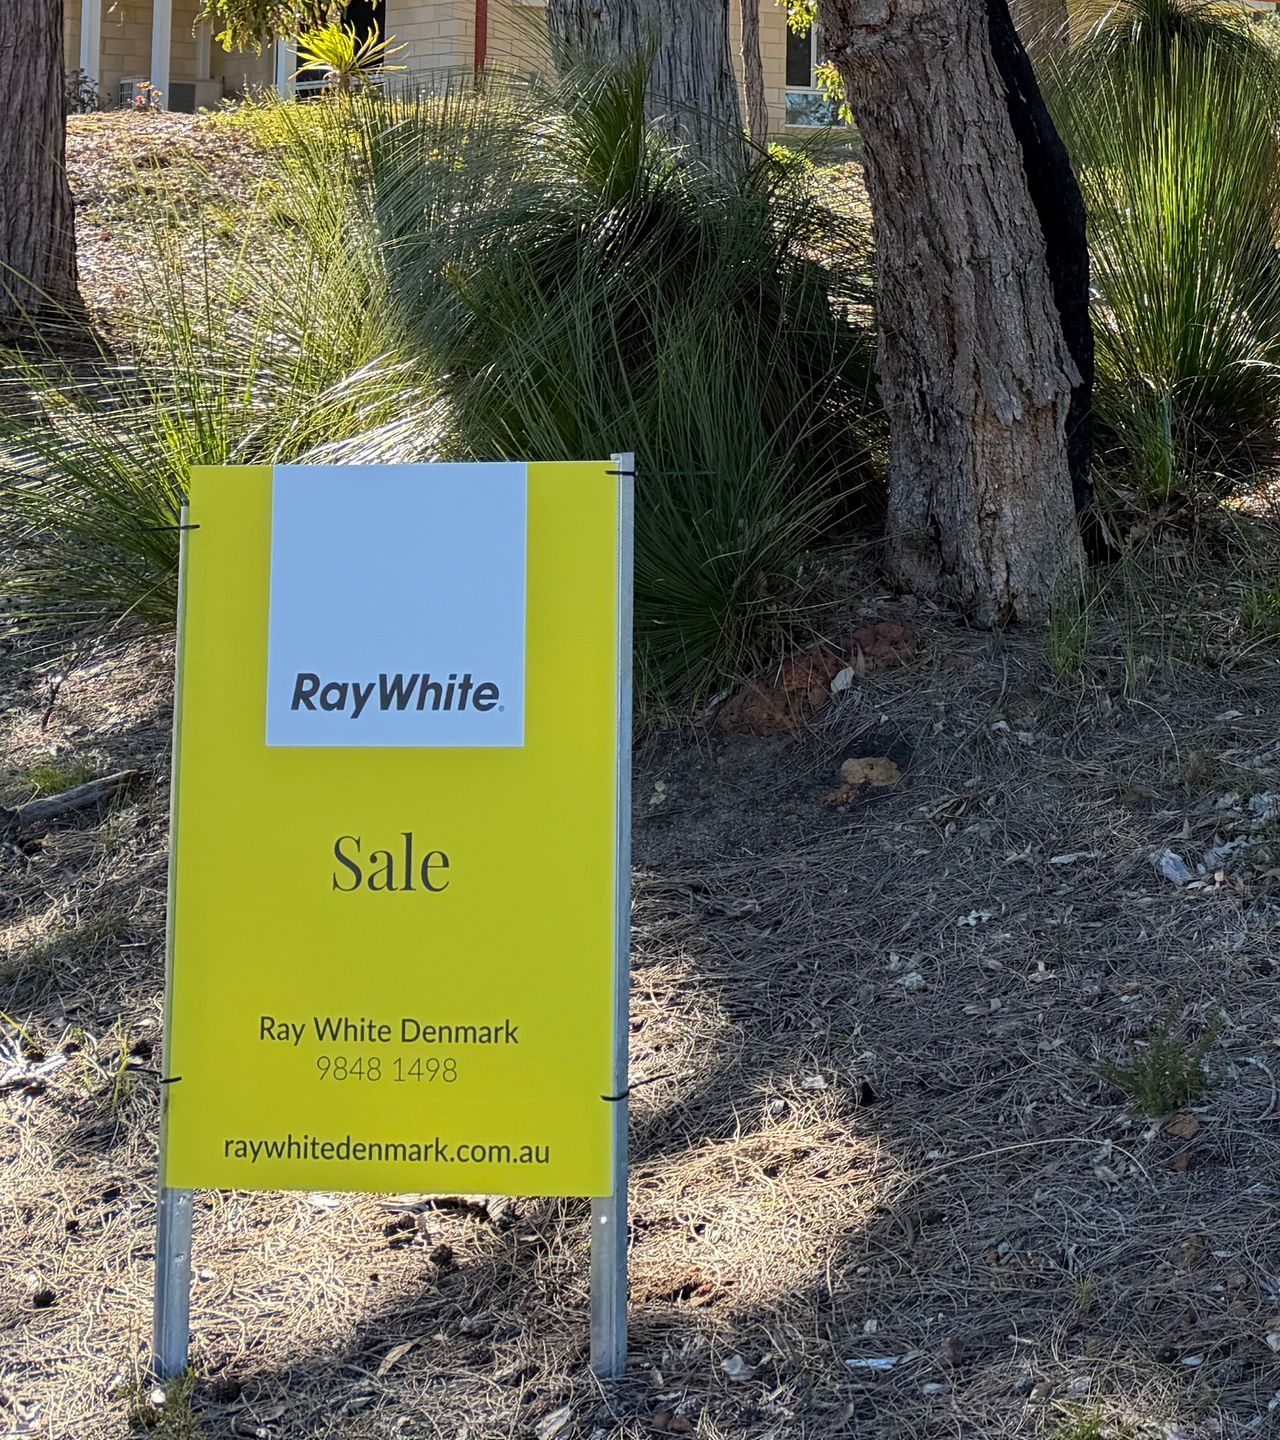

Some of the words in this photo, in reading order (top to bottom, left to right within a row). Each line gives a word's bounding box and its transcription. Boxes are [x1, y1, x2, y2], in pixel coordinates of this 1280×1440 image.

[332, 831, 450, 892] Sale
[259, 1015, 305, 1046] Ray
[313, 1016, 391, 1043] White
[401, 1018, 519, 1044] Denmark
[316, 1055, 381, 1081] 9848
[393, 1057, 457, 1083] 1498
[224, 1134, 550, 1164] raywhitedenmark.com.au
